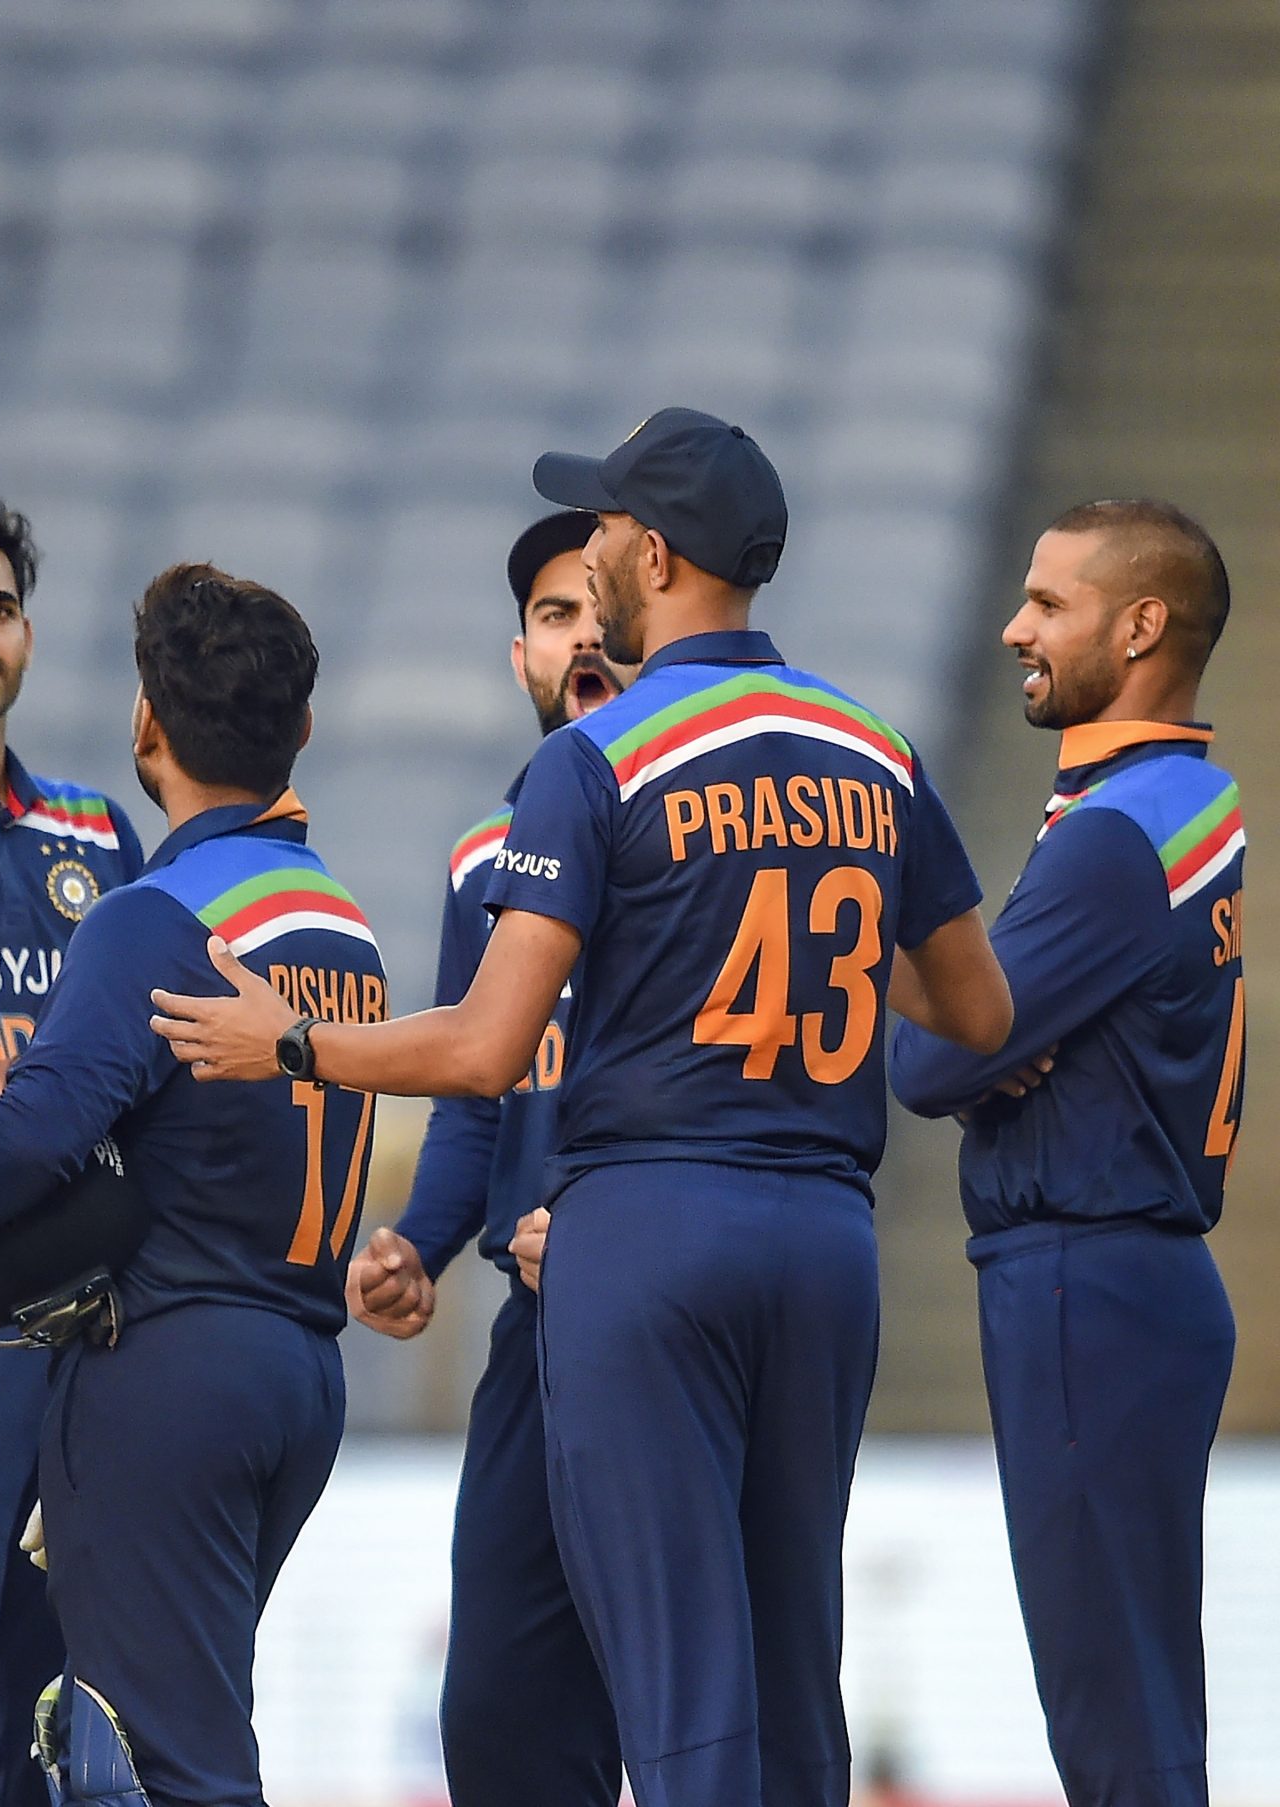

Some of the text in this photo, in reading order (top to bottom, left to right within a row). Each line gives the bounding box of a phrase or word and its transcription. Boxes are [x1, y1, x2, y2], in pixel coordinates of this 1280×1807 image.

[663, 774, 898, 862] PRASIDH
[493, 848, 561, 881] BYJU'S
[268, 964, 390, 1025] RISHAB
[692, 866, 883, 1085] 43
